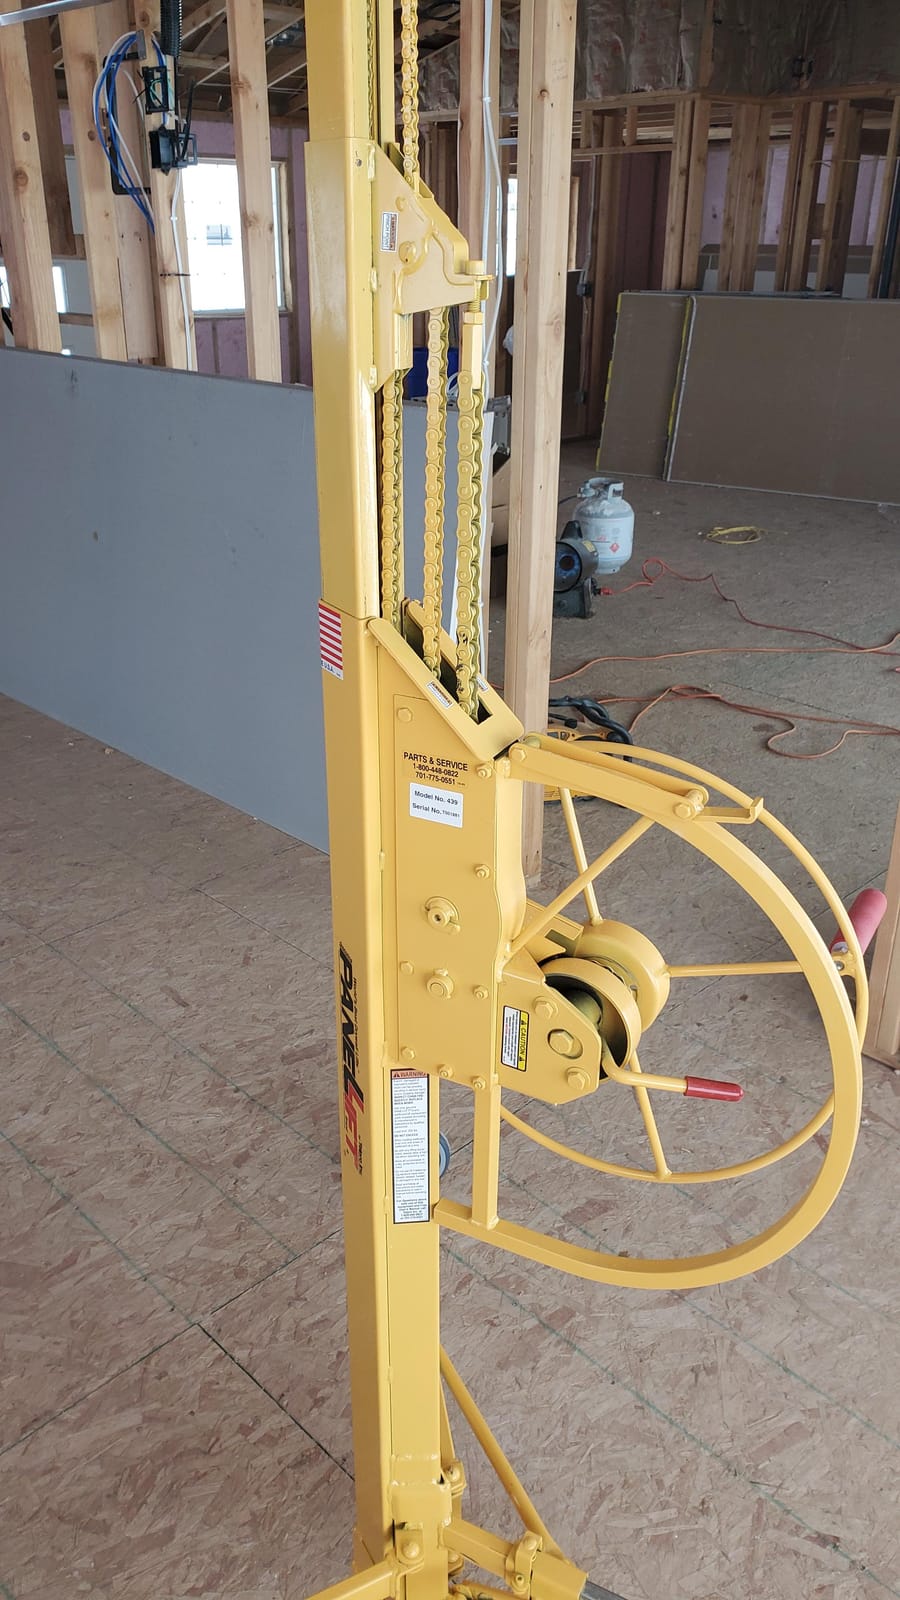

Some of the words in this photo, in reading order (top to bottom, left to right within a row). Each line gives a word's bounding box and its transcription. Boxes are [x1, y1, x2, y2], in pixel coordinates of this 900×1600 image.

[403, 751, 428, 764] PARTS
[429, 756, 434, 764] &
[436, 758, 468, 772] SERVICE
[416, 772, 456, 785] 701-775-0551
[414, 790, 434, 800] Model
[412, 802, 430, 812] Serial
[431, 807, 442, 815] No.
